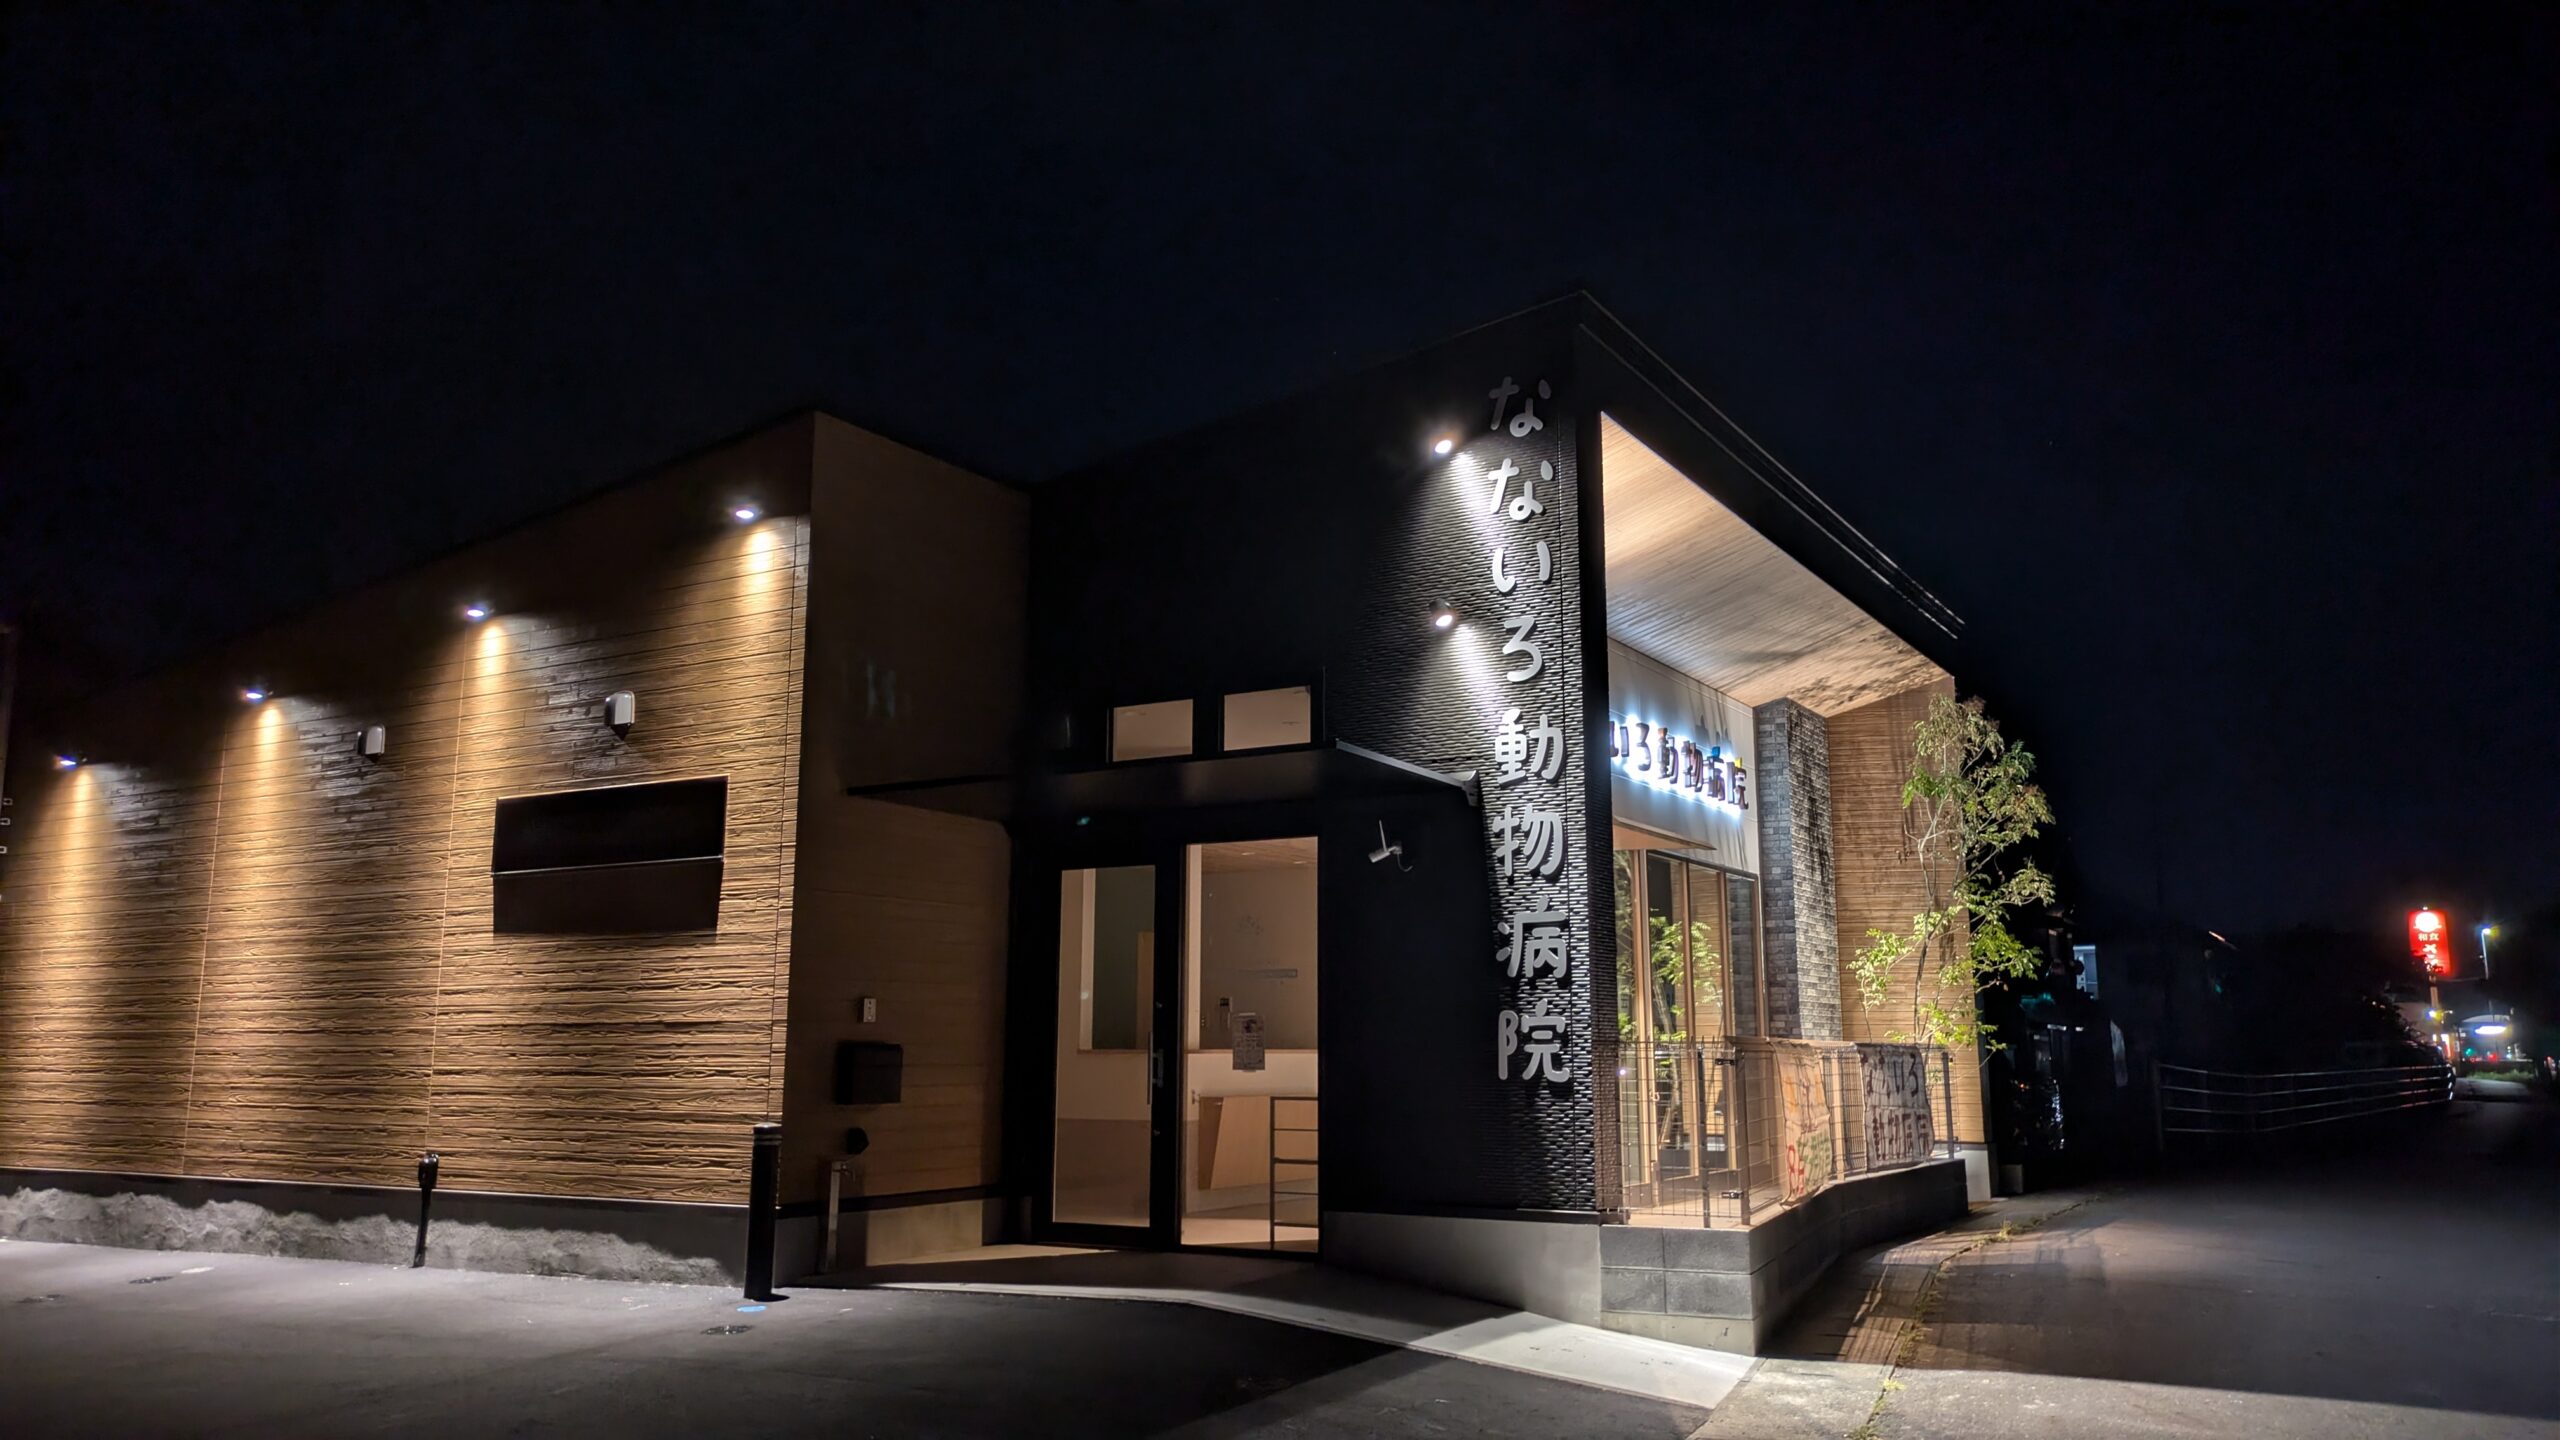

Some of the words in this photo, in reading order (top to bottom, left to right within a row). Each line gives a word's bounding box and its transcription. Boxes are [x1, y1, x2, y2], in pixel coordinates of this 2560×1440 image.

[1488, 375, 1571, 1083] なないろ動物病院
